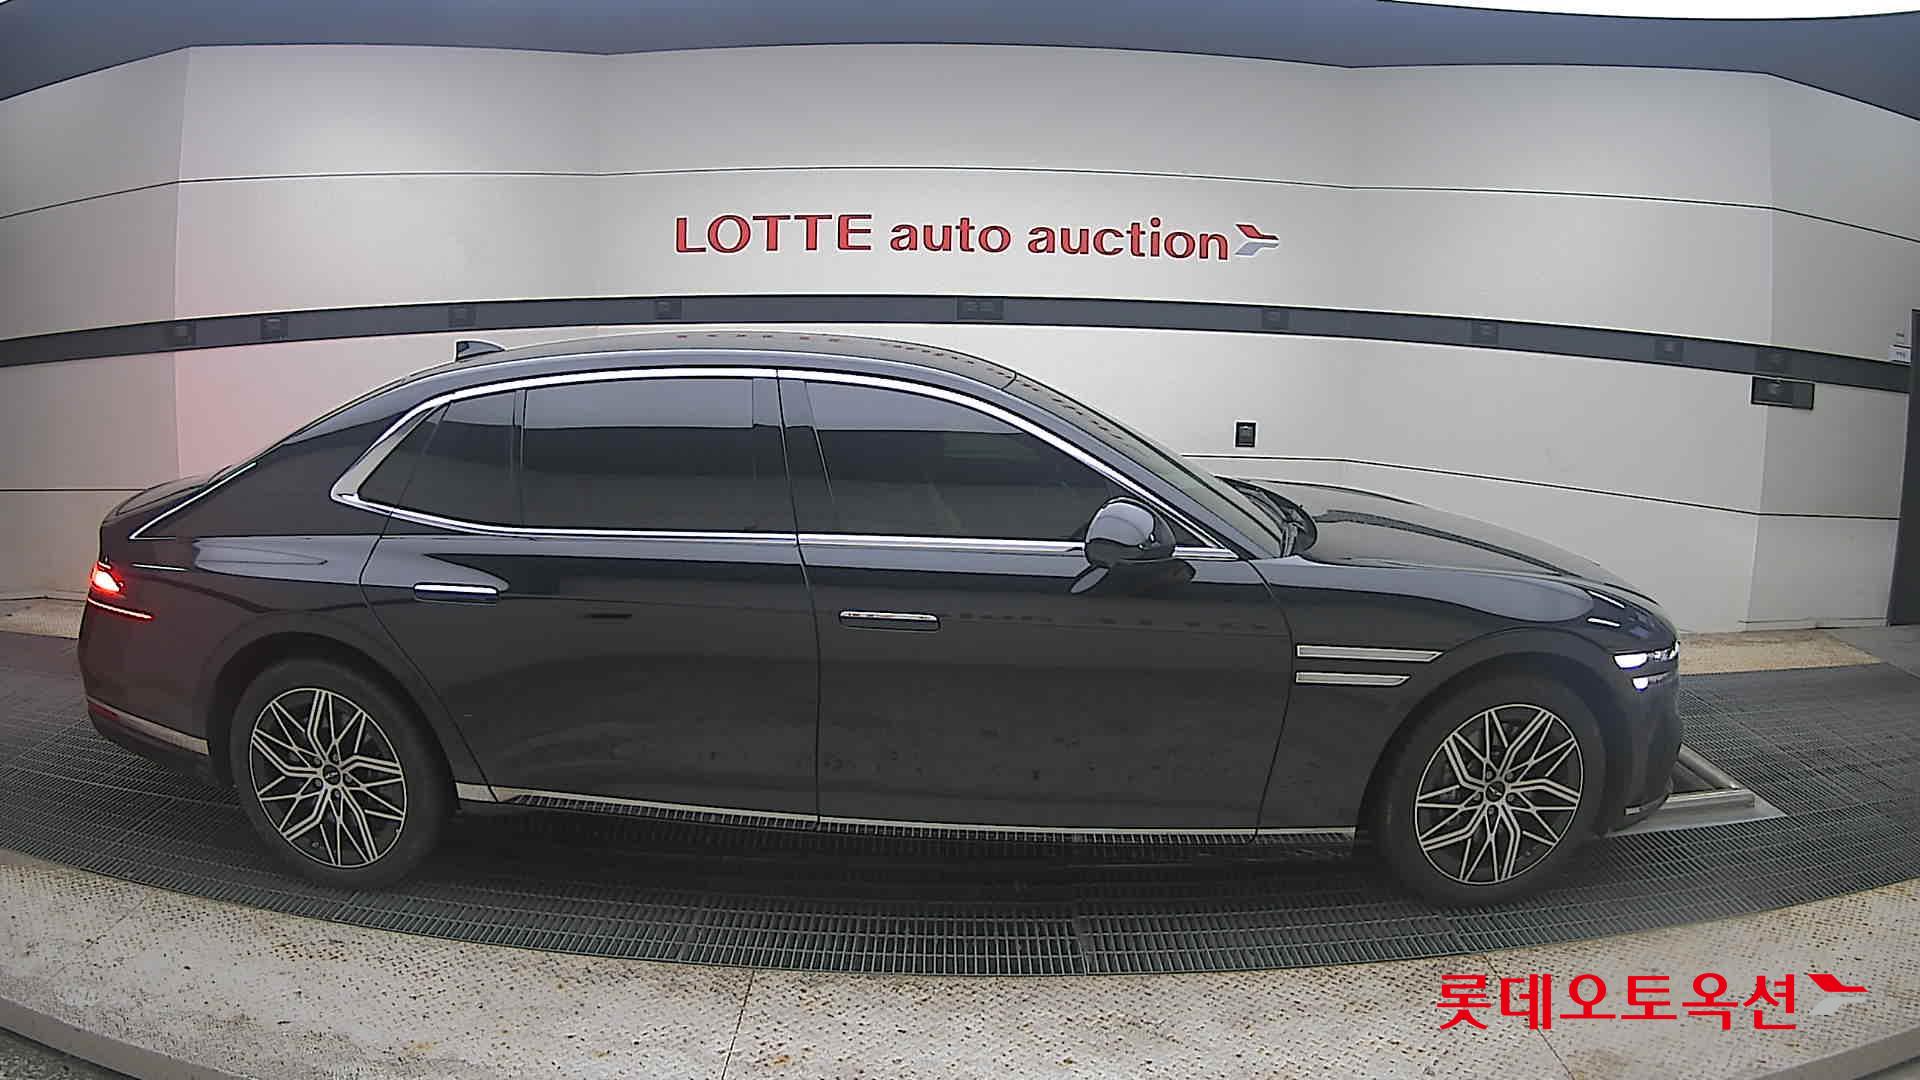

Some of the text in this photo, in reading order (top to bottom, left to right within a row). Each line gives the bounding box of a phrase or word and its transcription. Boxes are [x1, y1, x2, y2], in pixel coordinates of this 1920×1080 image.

[675, 213, 1229, 260] LOTTE auto auction
